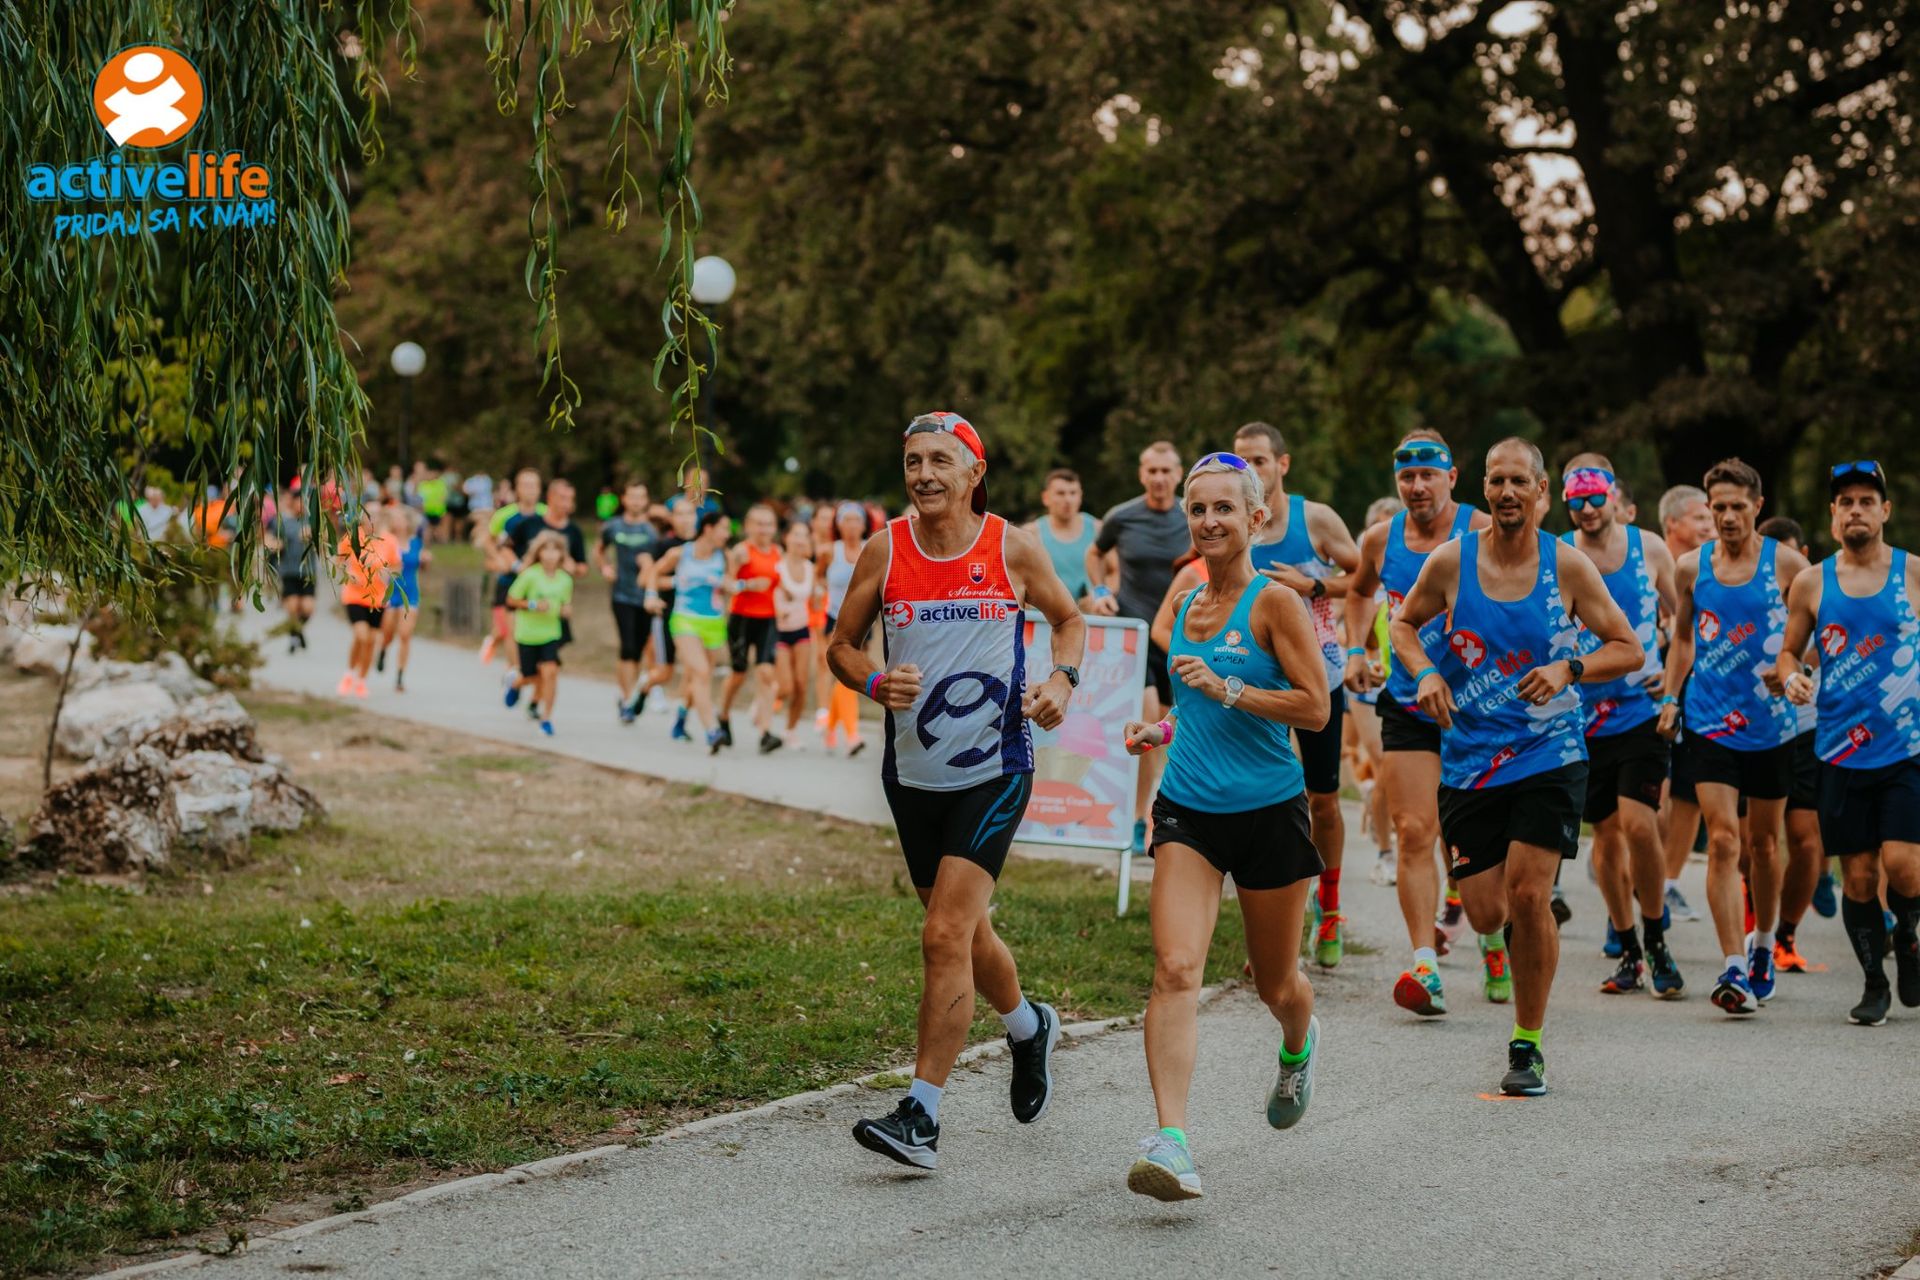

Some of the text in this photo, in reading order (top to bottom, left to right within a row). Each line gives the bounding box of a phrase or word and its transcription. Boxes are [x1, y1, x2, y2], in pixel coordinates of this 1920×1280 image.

[920, 602, 1006, 622] activelife
[1213, 655, 1246, 665] WOMEN
[1456, 648, 1535, 708] activelife
[1841, 661, 1878, 691] team
[1477, 682, 1519, 715] team
